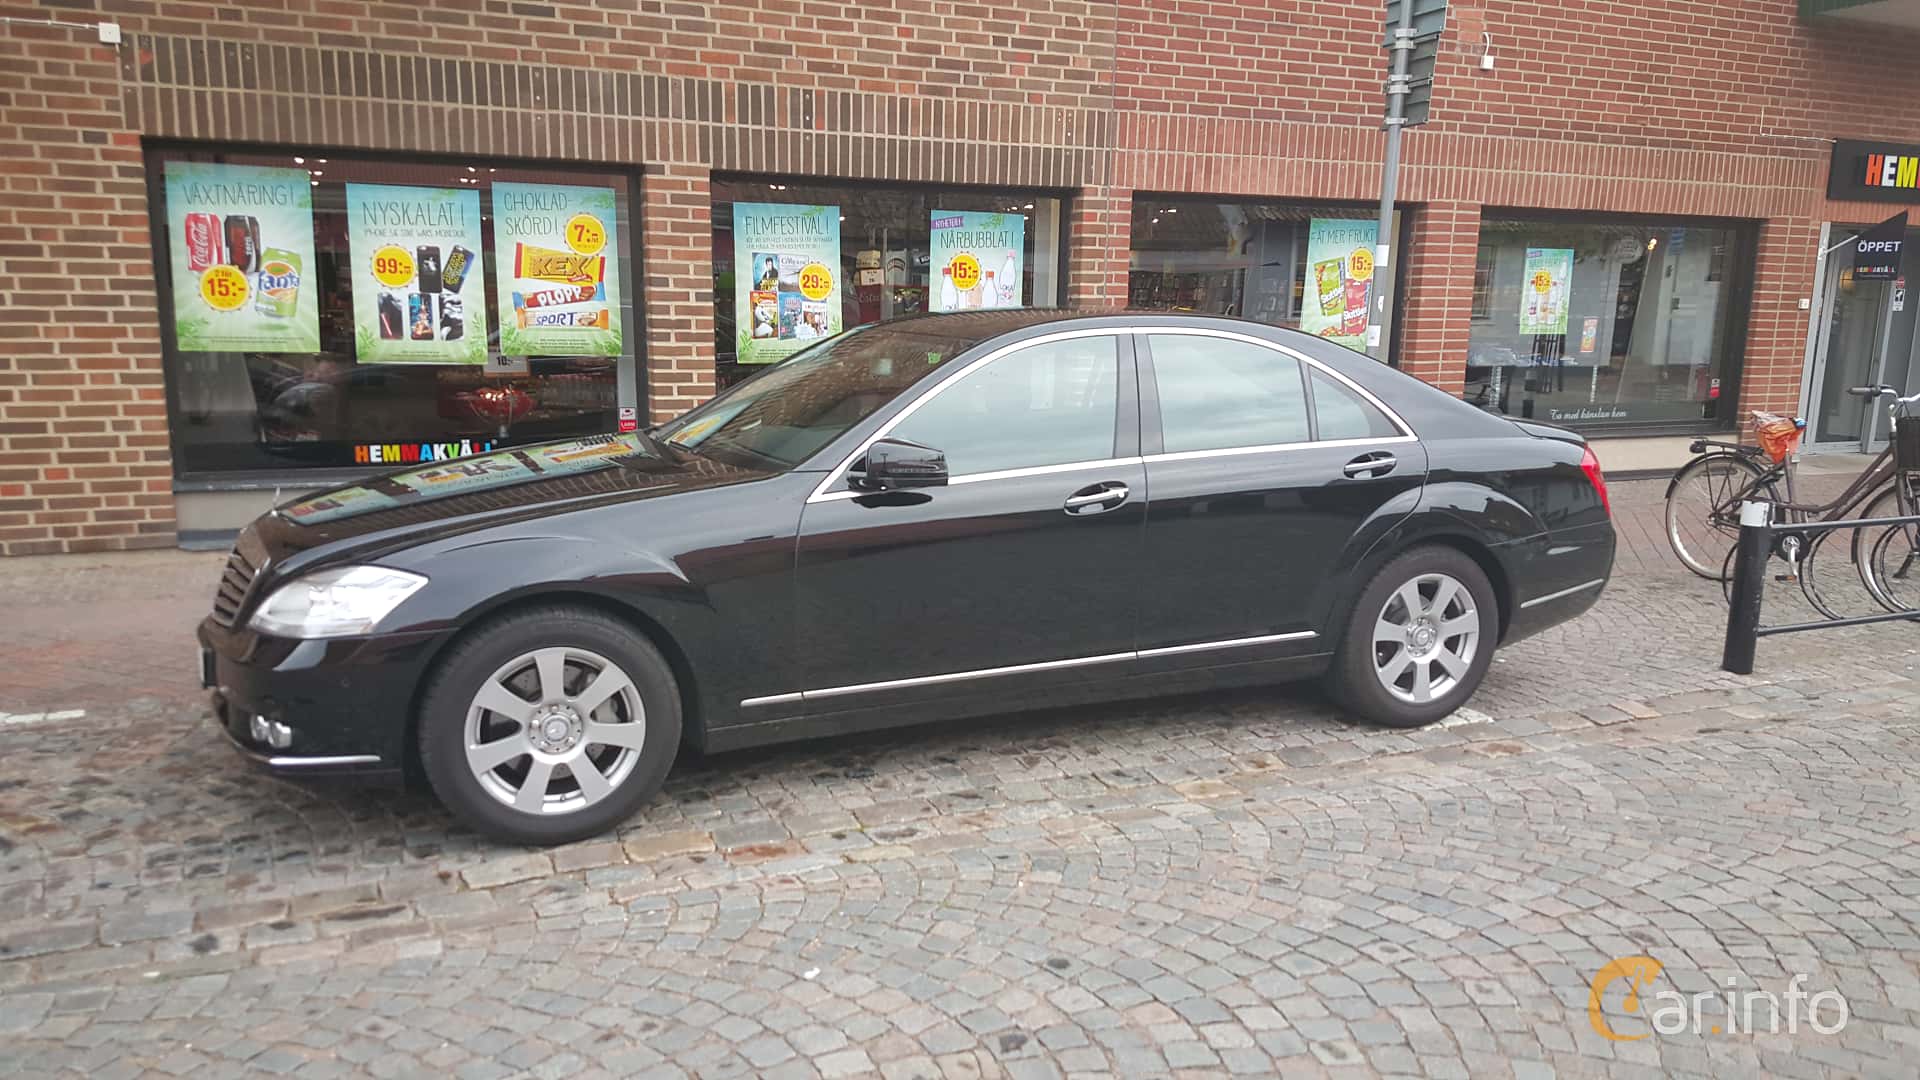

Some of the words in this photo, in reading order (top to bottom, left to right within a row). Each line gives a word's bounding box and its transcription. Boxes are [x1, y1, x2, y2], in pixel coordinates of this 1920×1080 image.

[1865, 154, 1920, 189] HEM
[503, 192, 571, 212] CHOKLAD-
[1858, 239, 1902, 252] ÖPPET
[533, 254, 590, 276] KEX
[207, 278, 246, 297] 15:-
[536, 286, 582, 306] PLOPP
[535, 311, 577, 327] SPORT
